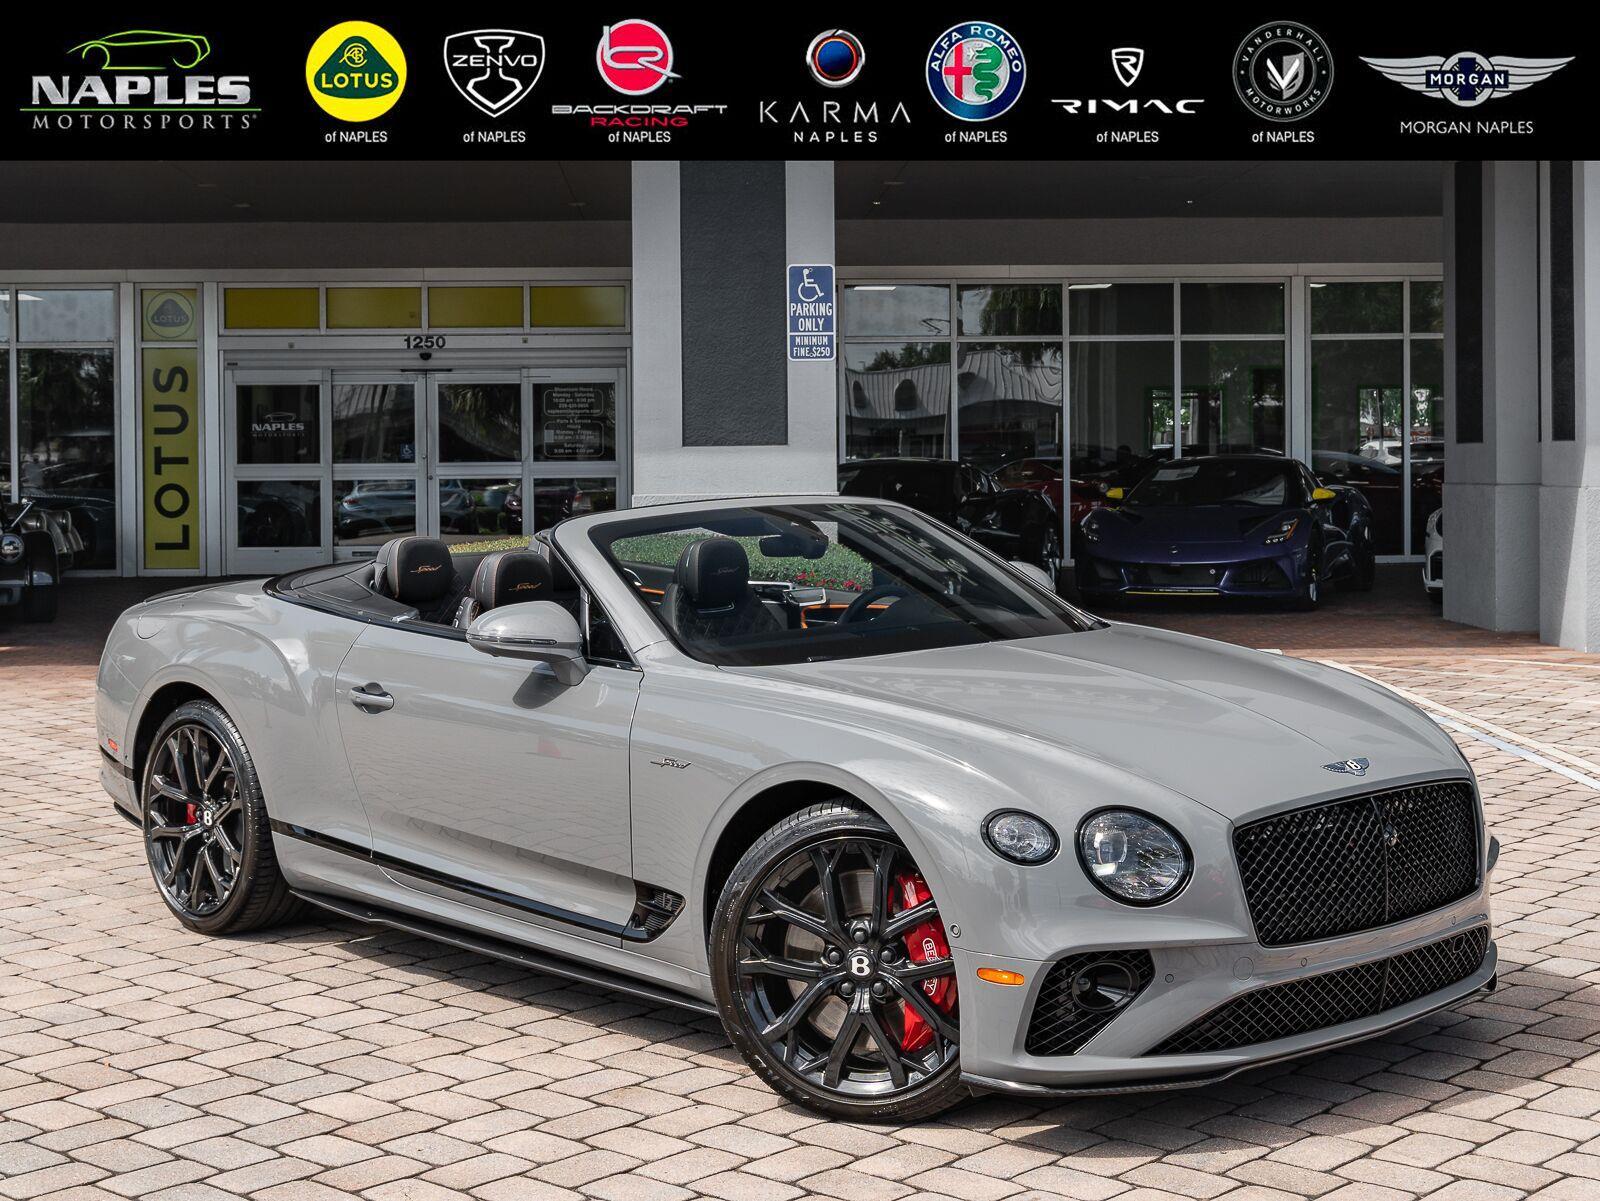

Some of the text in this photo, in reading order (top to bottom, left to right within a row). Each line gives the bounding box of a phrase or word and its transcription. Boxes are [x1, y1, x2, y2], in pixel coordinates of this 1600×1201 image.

[790, 303, 832, 316] PARKING
[154, 315, 187, 324] LOTUS
[798, 318, 824, 331] ONLY
[404, 336, 446, 349] 1250
[795, 336, 828, 345] MINIMUM
[793, 346, 831, 357] FINE $250
[252, 423, 305, 431] NAPLES
[153, 365, 190, 550] LOTUS
[851, 956, 871, 976] B
